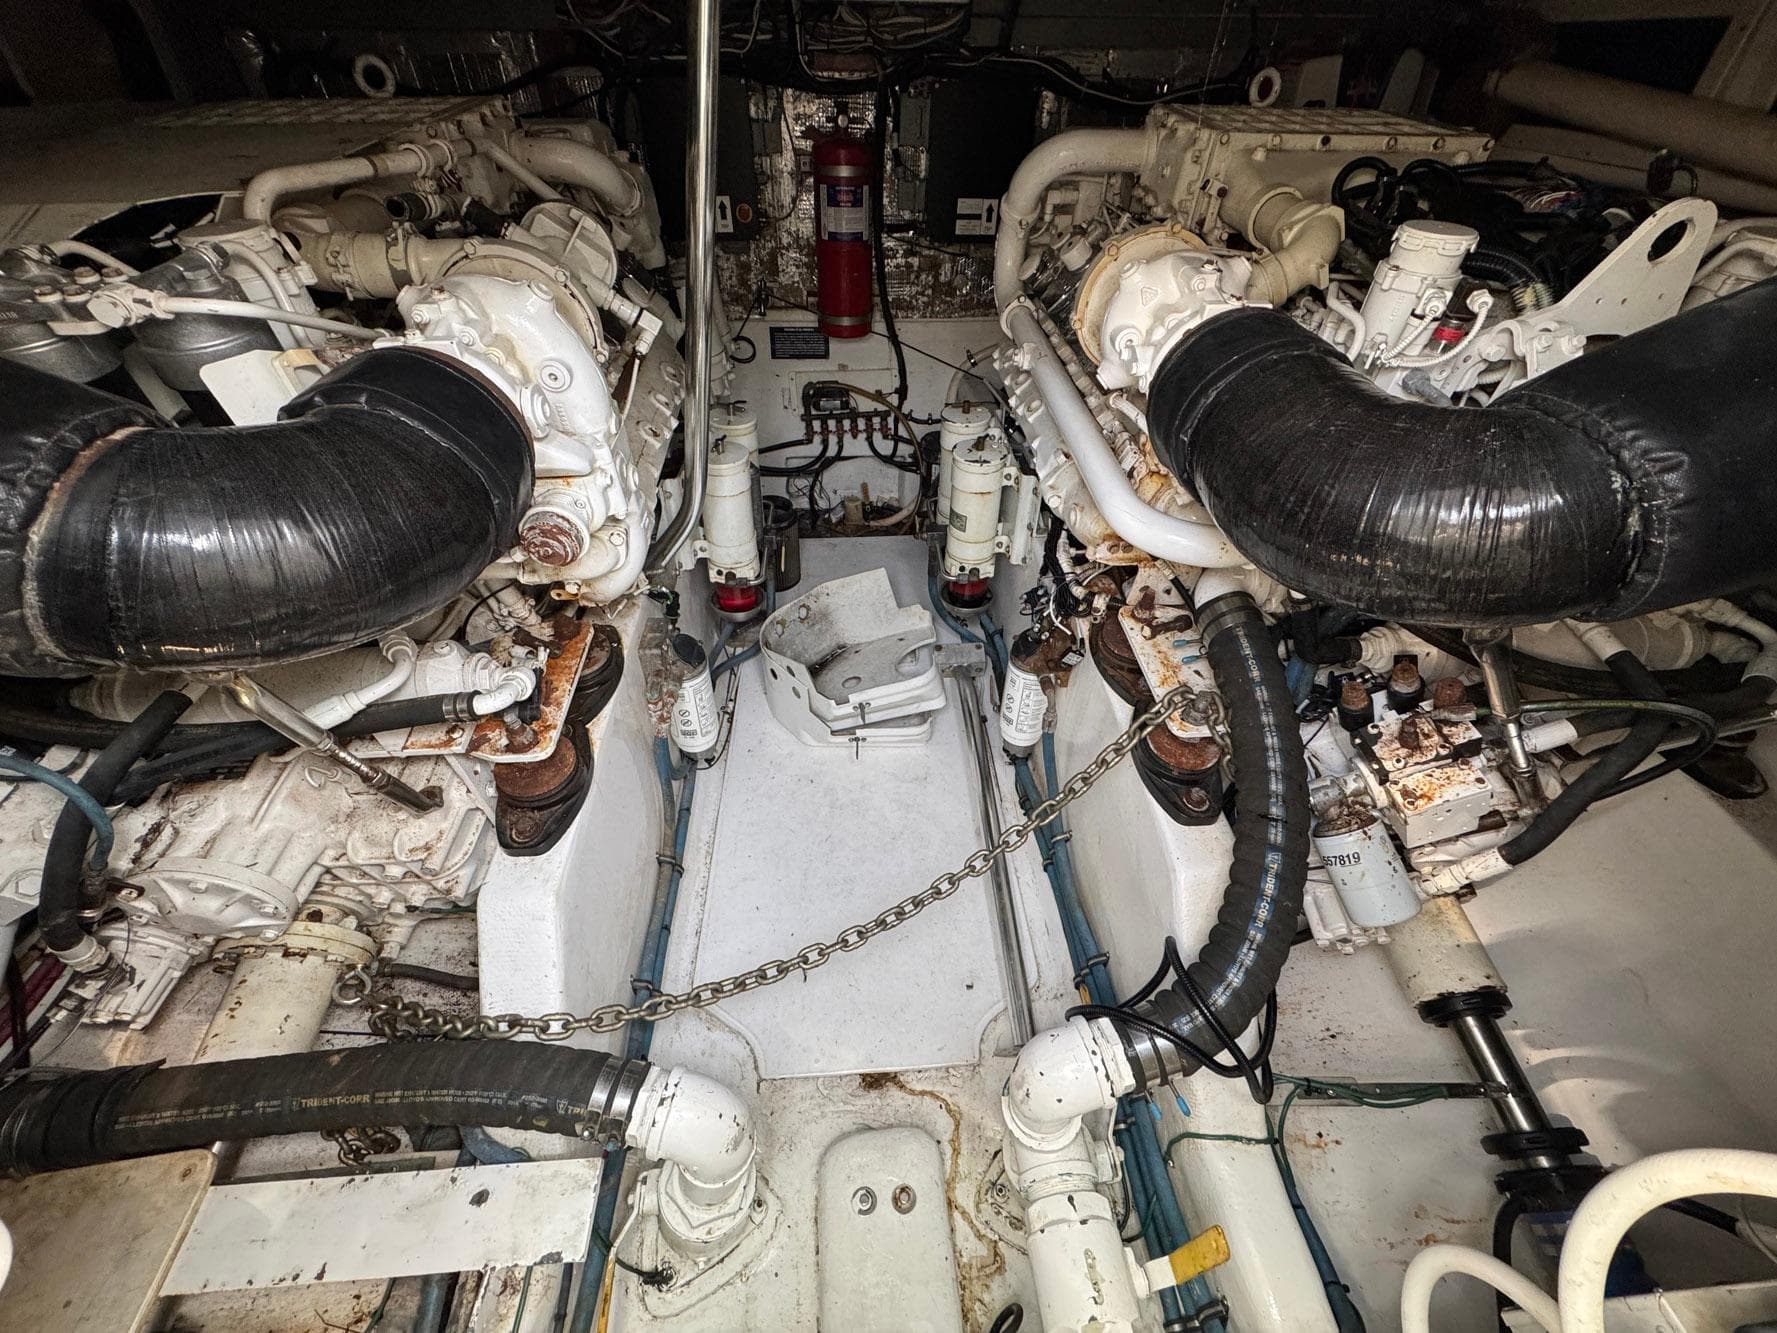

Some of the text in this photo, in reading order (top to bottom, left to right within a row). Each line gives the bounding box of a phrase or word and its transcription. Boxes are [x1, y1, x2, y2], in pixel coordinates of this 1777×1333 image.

[1322, 851, 1361, 867] 557819
[1254, 863, 1278, 928] TRIDENT-CORR
[301, 1094, 370, 1108] TRIDENT-CORR
